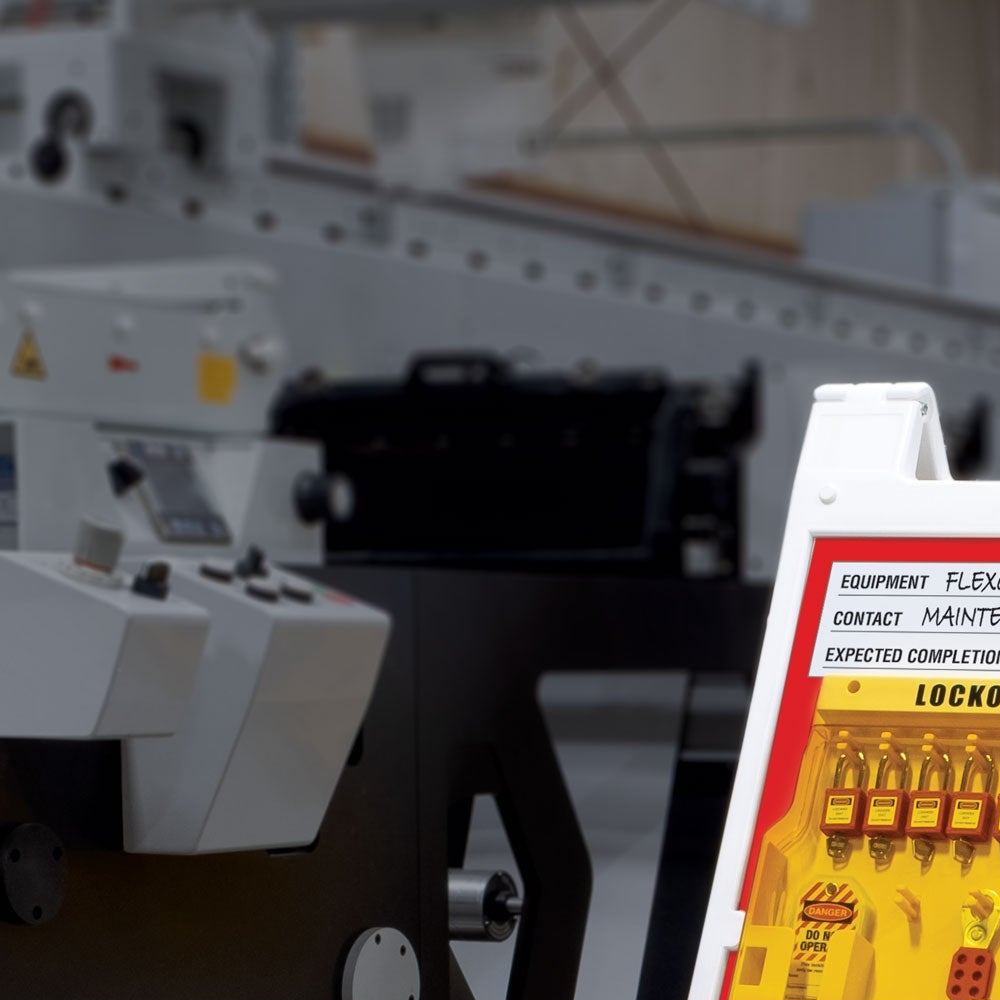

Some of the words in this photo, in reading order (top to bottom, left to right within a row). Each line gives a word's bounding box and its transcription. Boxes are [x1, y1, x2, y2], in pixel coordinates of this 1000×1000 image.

[841, 575, 929, 589] EQUIPMENT
[834, 611, 903, 626] CONTACT
[826, 648, 902, 662] EXPECTED
[808, 907, 848, 917] DANGER
[806, 930, 820, 940] DO
